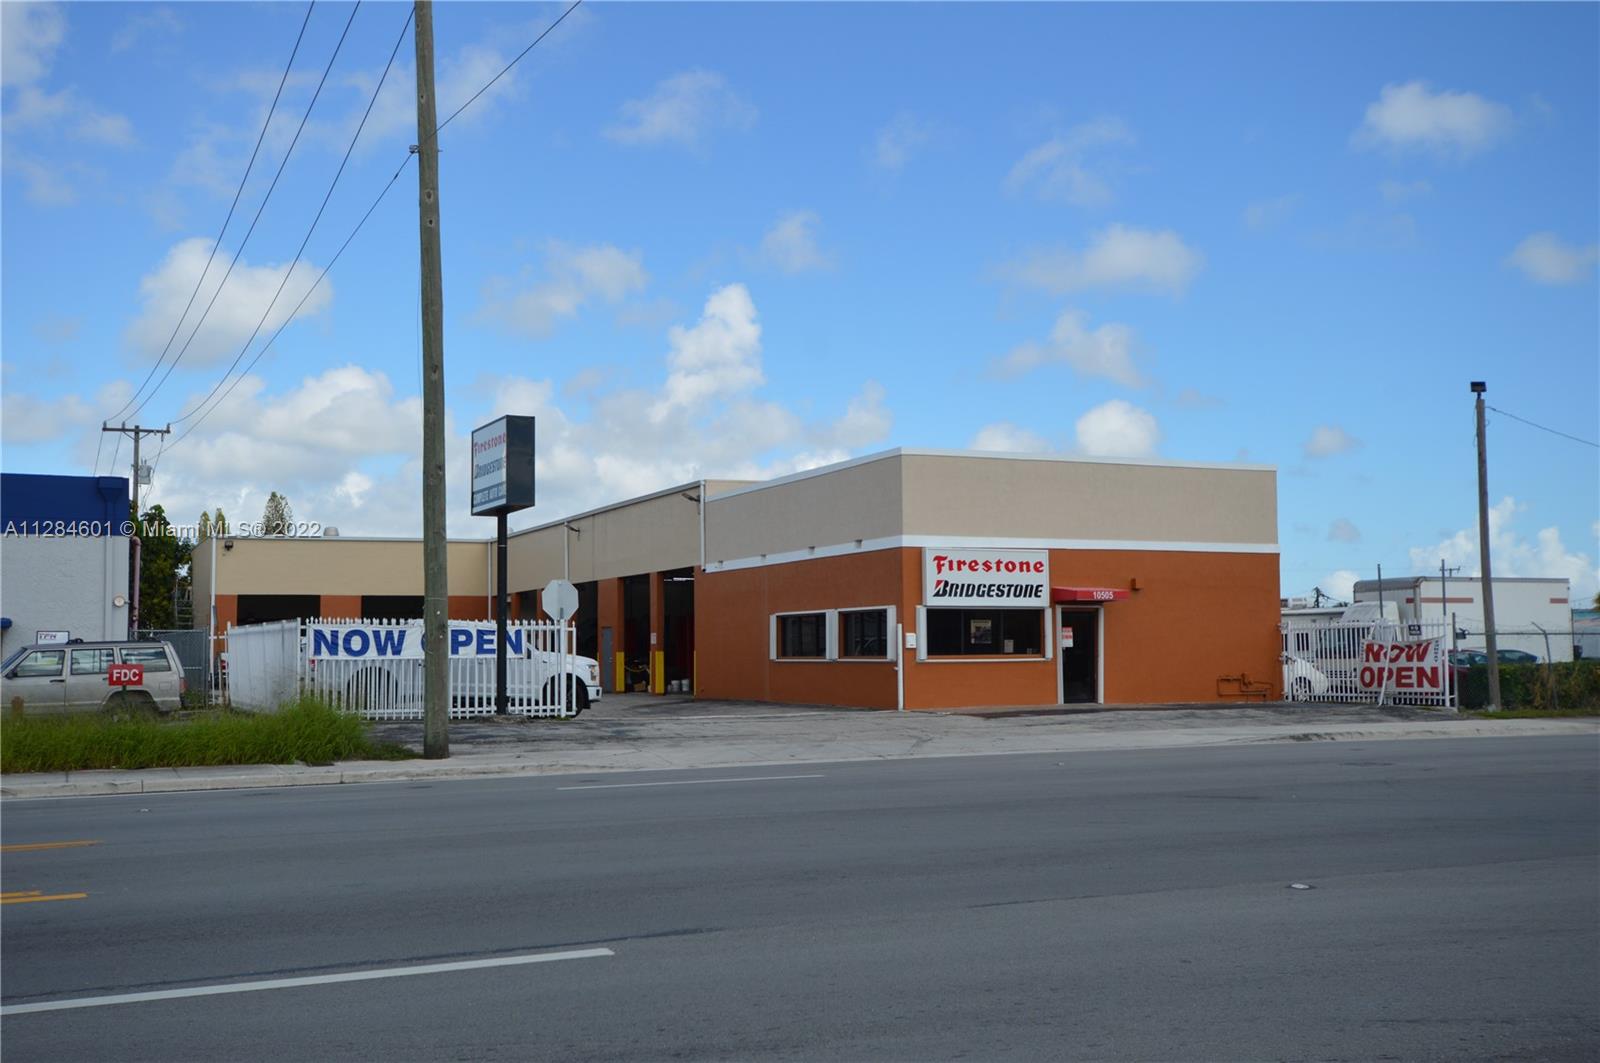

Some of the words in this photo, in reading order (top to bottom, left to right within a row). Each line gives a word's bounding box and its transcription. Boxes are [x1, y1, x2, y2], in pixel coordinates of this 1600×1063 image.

[932, 554, 1045, 575] Firestone
[933, 579, 1044, 598] BRIDGESTONE
[1093, 591, 1114, 600] 10505
[313, 629, 407, 657] NOW
[421, 628, 523, 656] PEN
[1365, 641, 1433, 664] NOW
[113, 669, 139, 681] FDC
[1360, 666, 1440, 689] OPEN
